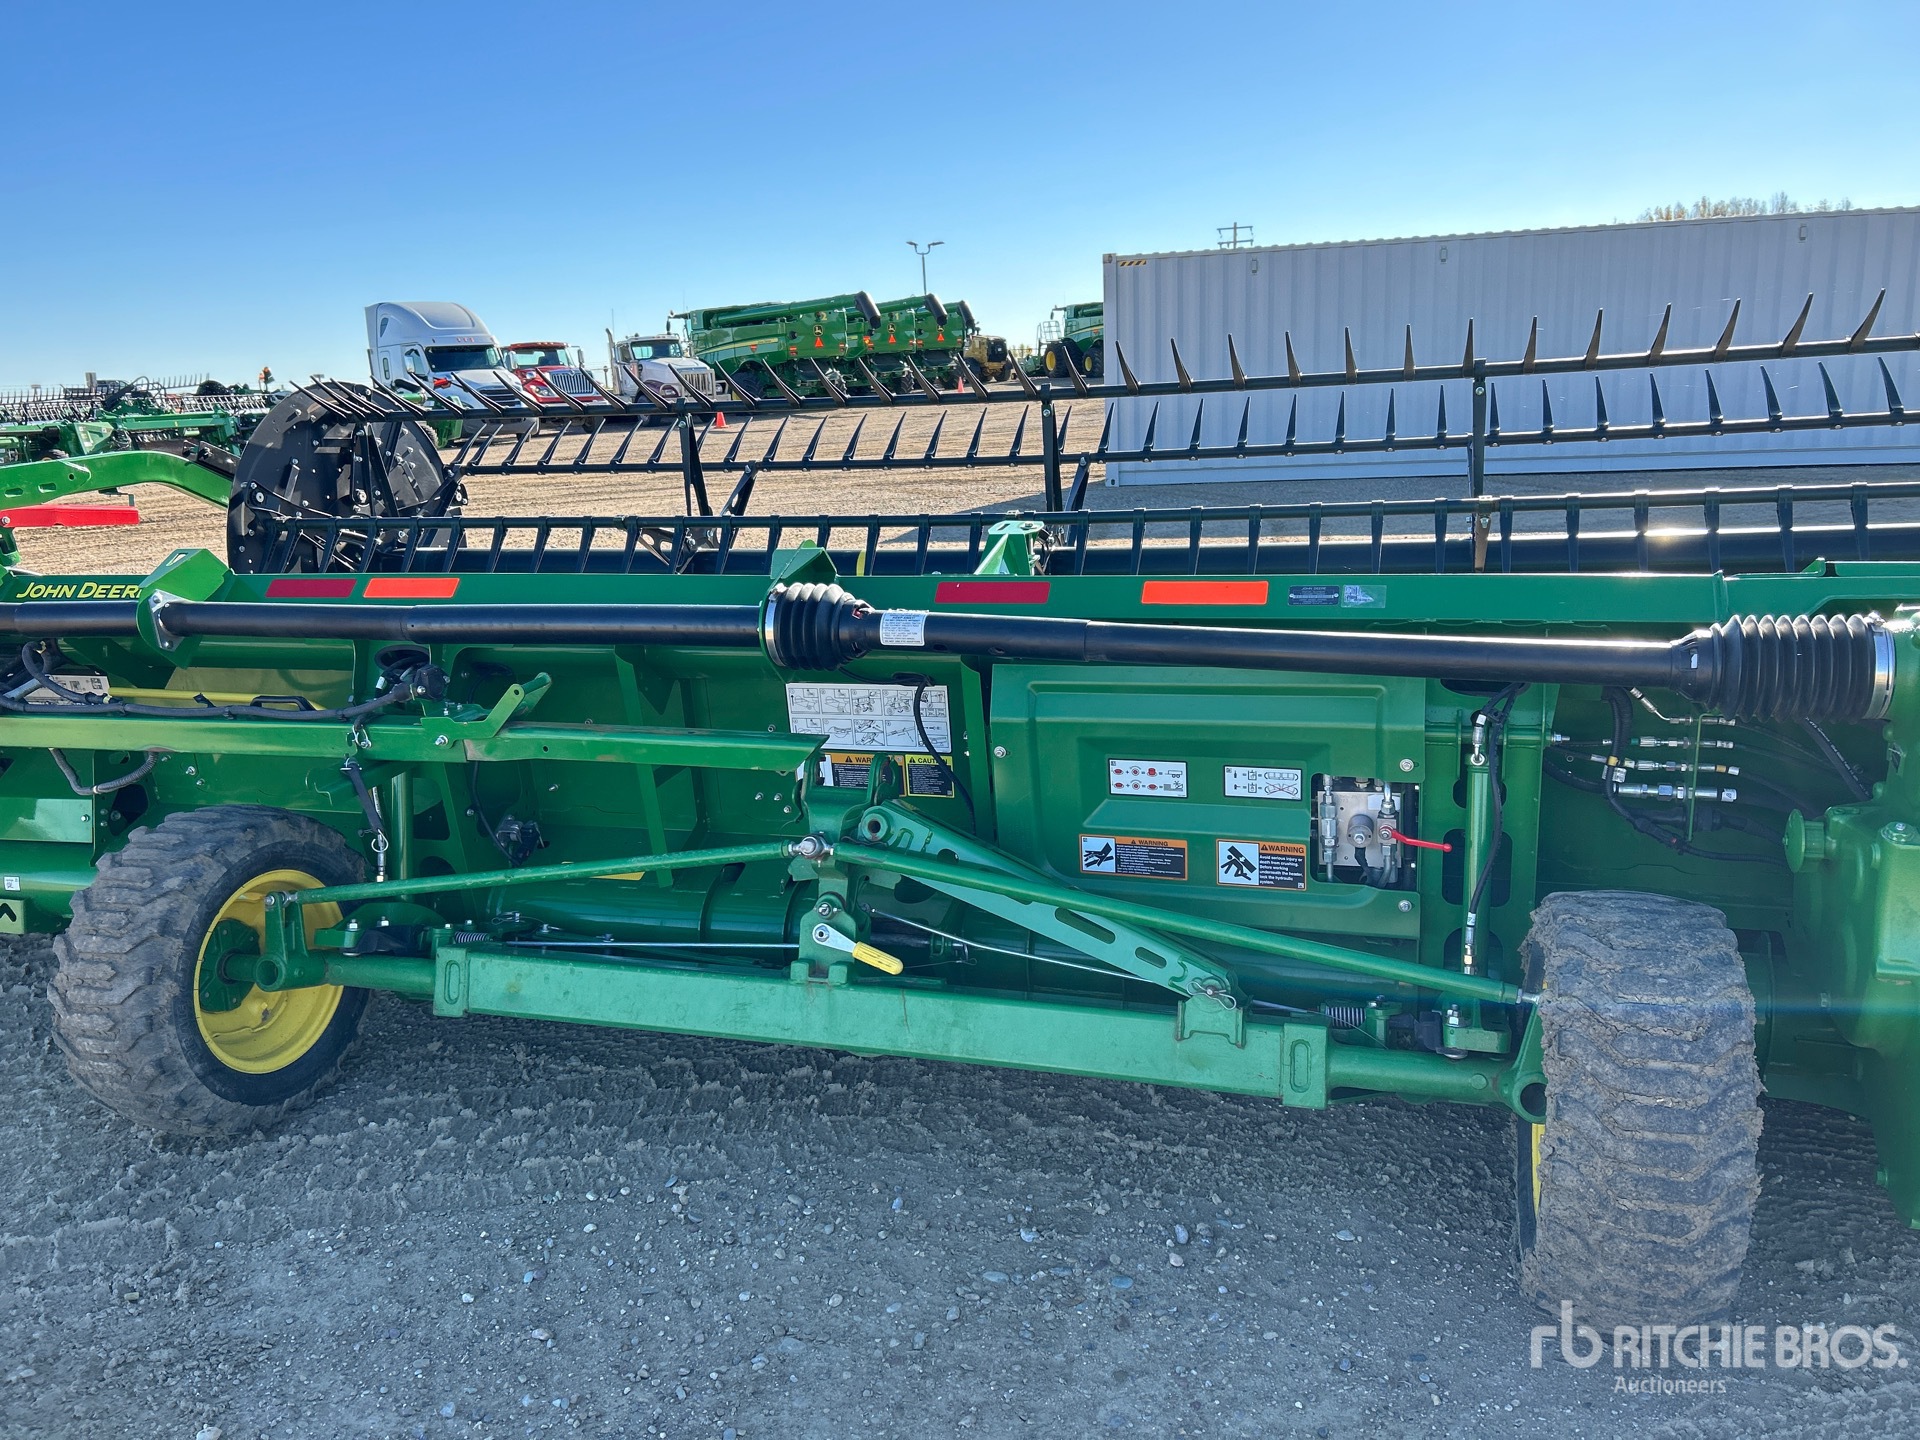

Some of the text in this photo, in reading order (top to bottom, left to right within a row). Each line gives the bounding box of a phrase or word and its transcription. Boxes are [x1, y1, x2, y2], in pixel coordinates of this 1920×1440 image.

[16, 582, 142, 598] JOHN DEER
[1138, 839, 1169, 847] WARNING
[1269, 845, 1304, 854] WARNING
